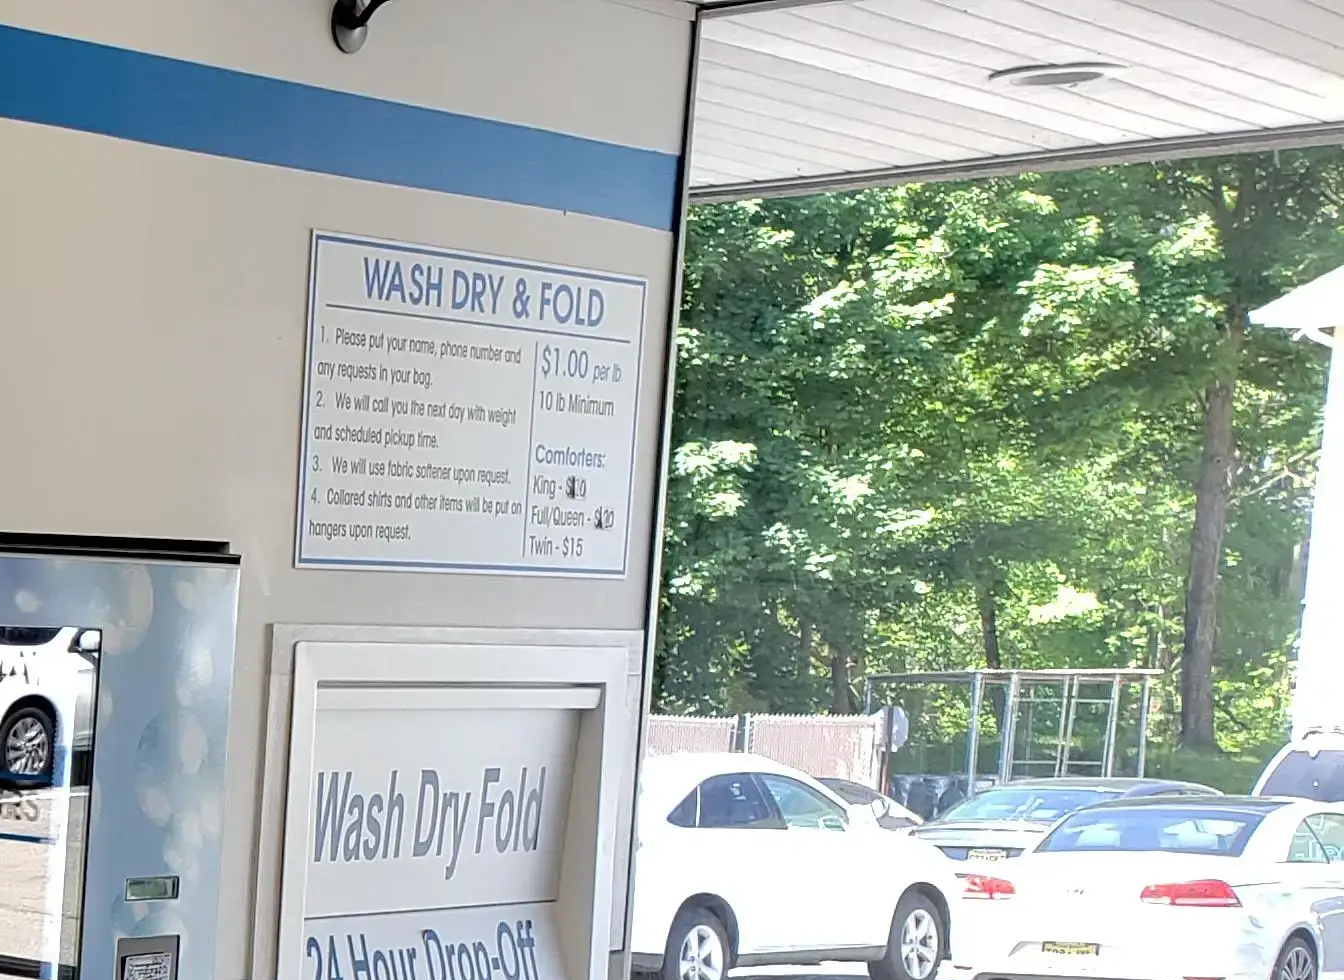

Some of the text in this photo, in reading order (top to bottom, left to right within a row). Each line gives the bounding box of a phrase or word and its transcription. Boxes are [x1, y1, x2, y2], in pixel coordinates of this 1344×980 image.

[364, 257, 604, 327] WASH DRY & FOLD
[336, 328, 366, 346] Please
[369, 333, 384, 350] put
[387, 338, 406, 353] your
[440, 342, 467, 359] phone
[470, 345, 502, 360] number
[505, 348, 521, 364] and
[318, 361, 432, 389] any requests in your bag.
[541, 345, 621, 384] $1.00 per lb
[336, 392, 351, 409] We
[354, 394, 369, 411] will
[372, 397, 388, 413] call
[391, 401, 407, 417] you
[411, 399, 424, 416] the
[427, 403, 446, 418] next
[448, 403, 465, 423] day
[467, 404, 485, 421] with
[488, 409, 516, 427] weight
[540, 391, 614, 416] 10 lb Minimum
[314, 425, 332, 440] and
[335, 426, 381, 444] scheduled
[384, 429, 414, 450] pickup
[332, 456, 347, 474] We
[351, 459, 366, 475] will
[369, 462, 384, 476] use
[387, 460, 413, 478] fabric
[416, 463, 451, 480] softener
[453, 469, 475, 484] upon
[535, 444, 605, 468] Comforters:
[533, 475, 556, 500] King
[327, 488, 365, 506] Collared
[368, 491, 391, 508] shirts
[394, 493, 411, 509] and
[414, 494, 437, 511] other
[439, 495, 462, 511] items
[465, 497, 480, 512] will
[482, 499, 492, 513] be
[495, 502, 509, 516] put
[511, 502, 522, 515] on
[309, 520, 346, 540] hangers
[349, 524, 372, 540] upon
[532, 506, 584, 527] Full/Queen
[530, 536, 552, 556] Twin
[563, 538, 583, 557] $15
[313, 766, 546, 880] Wash Dry Fold
